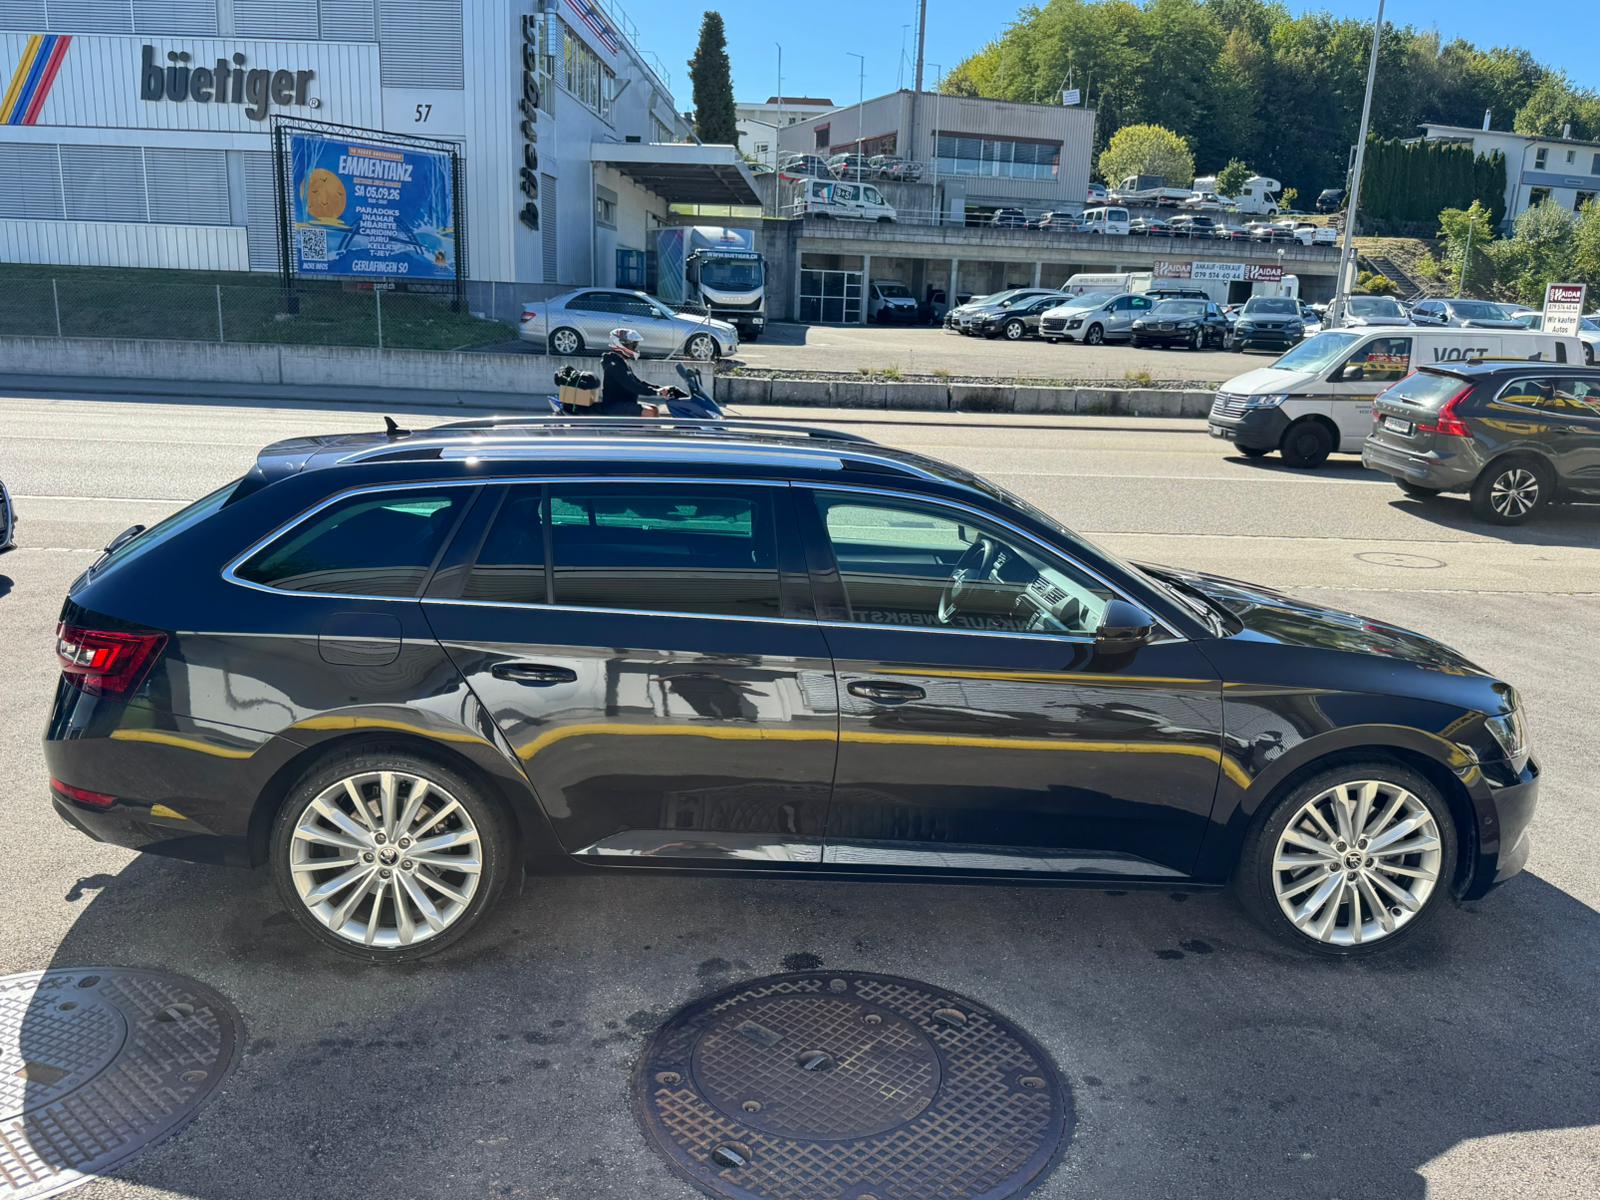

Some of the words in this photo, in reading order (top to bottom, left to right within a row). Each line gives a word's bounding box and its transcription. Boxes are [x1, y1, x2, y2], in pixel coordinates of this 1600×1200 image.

[141, 45, 315, 121] büetiger
[415, 104, 432, 122] 57
[338, 155, 413, 182] EMMENTANZ
[355, 185, 365, 197] SA
[366, 187, 400, 200] 05.09.26
[356, 206, 400, 216] PARADOKS
[362, 214, 394, 222] INAMAR
[1558, 316, 1577, 324] kaufen
